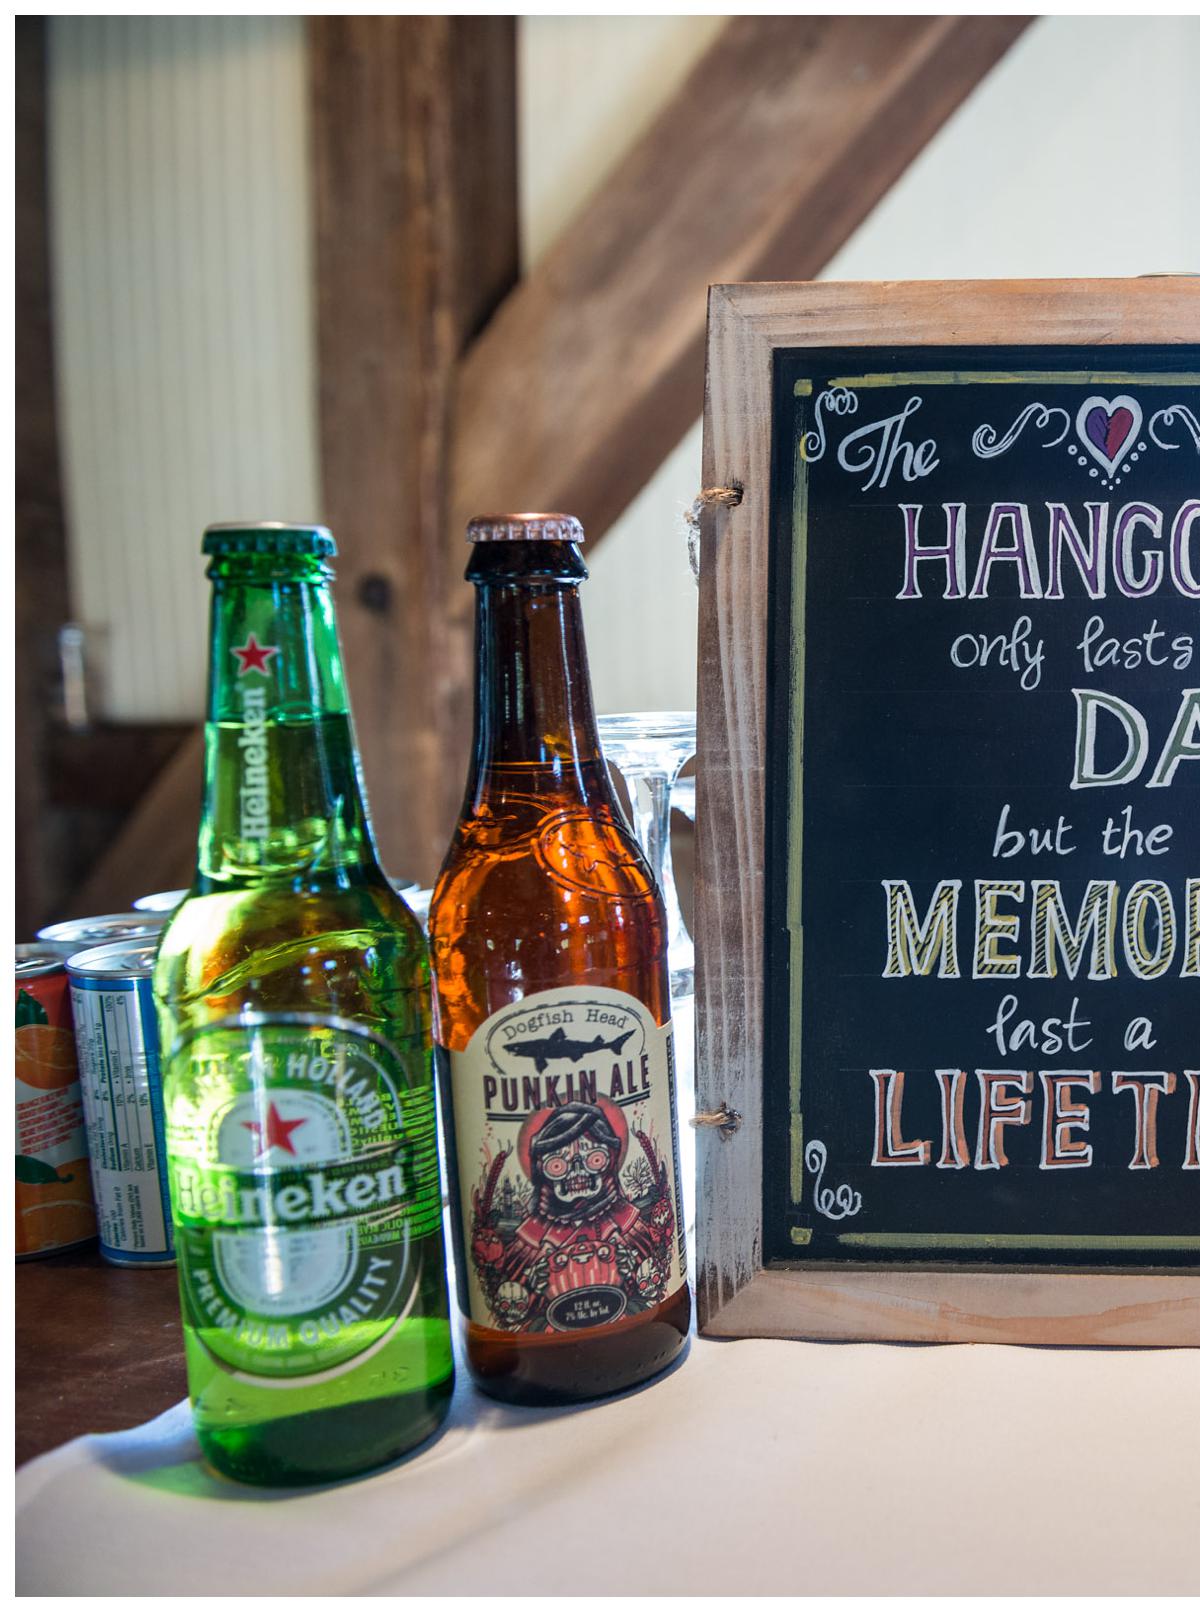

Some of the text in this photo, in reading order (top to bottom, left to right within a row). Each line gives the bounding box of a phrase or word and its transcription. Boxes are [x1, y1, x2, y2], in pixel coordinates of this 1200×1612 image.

[837, 396, 941, 492] The
[950, 615, 1045, 691] only
[1076, 615, 1194, 673] lasts
[238, 686, 270, 840] Heineken
[992, 804, 1175, 858] but the
[503, 1008, 628, 1041] Dogfish Head
[986, 994, 1158, 1056] last a
[288, 1050, 386, 1129] HOLLAND
[483, 1054, 652, 1112] PUNKIN ALE
[175, 1166, 406, 1225] Heineken
[194, 1268, 289, 1348] PREMIUM
[301, 1257, 393, 1345] QUALITY
